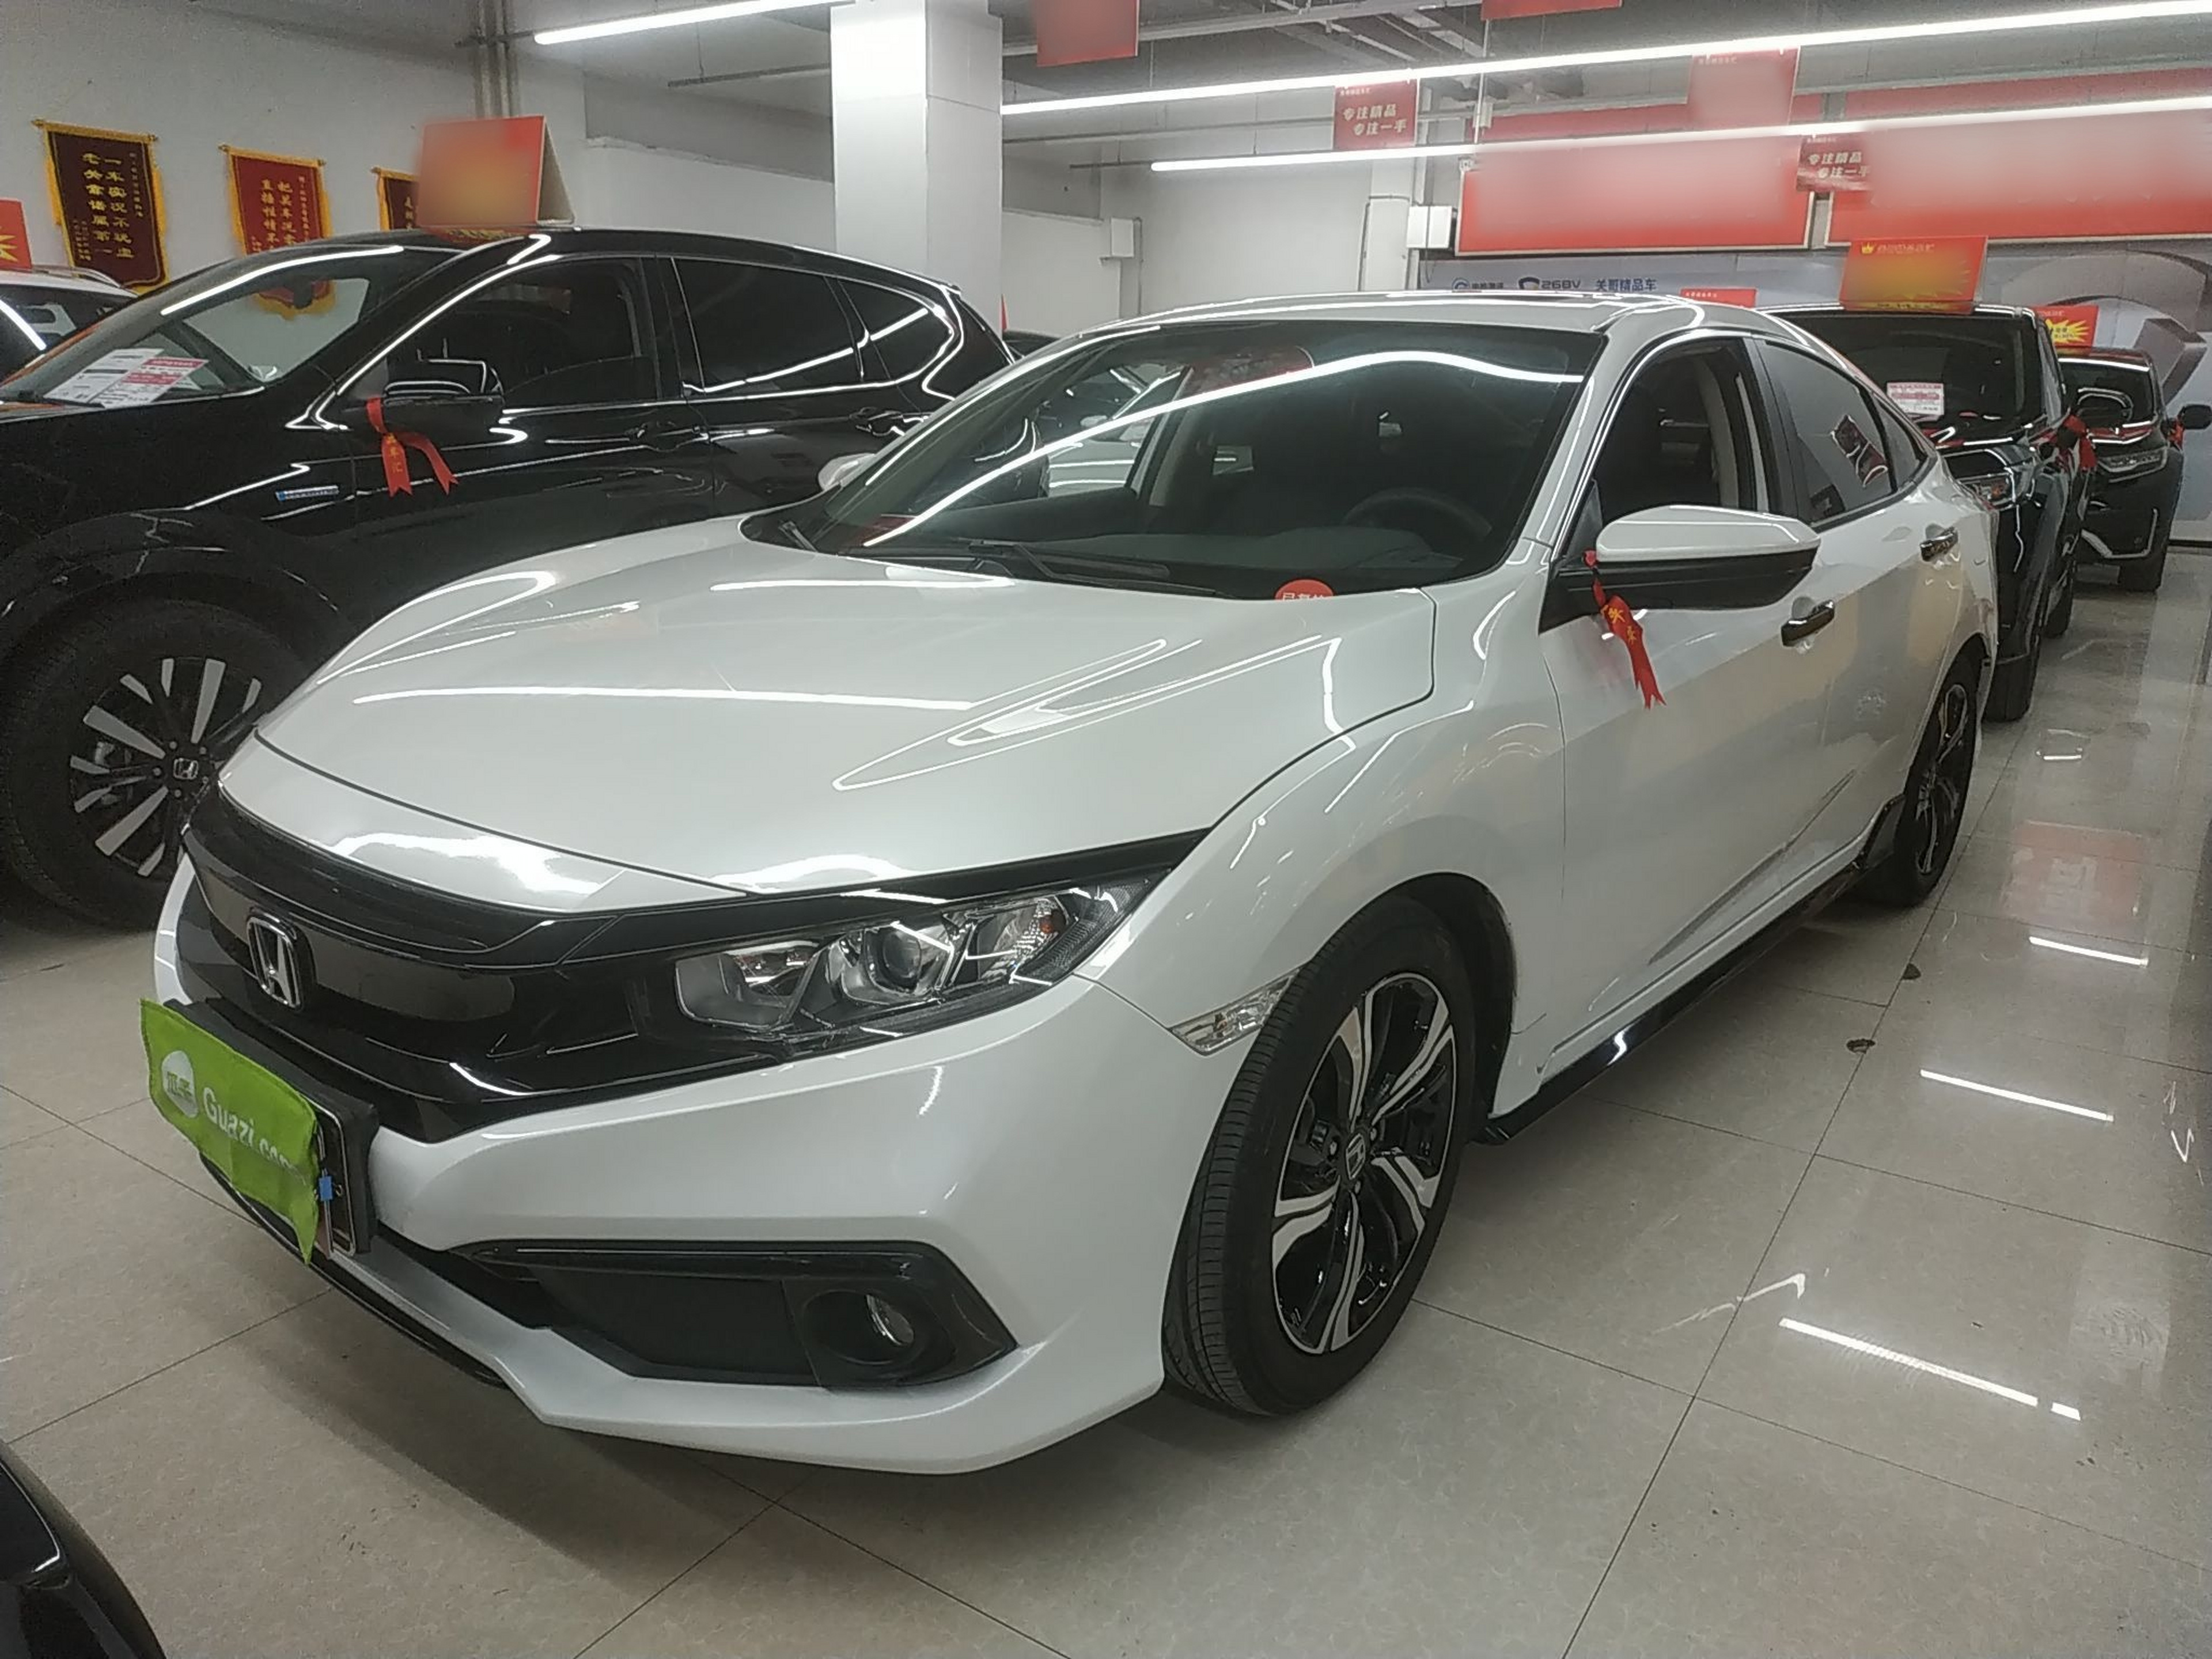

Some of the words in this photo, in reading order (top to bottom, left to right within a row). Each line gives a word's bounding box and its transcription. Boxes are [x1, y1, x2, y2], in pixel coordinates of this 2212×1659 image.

[1343, 104, 1397, 121] 专注精品
[1354, 119, 1407, 135] 专注一手
[1808, 151, 1862, 165] 专注精品
